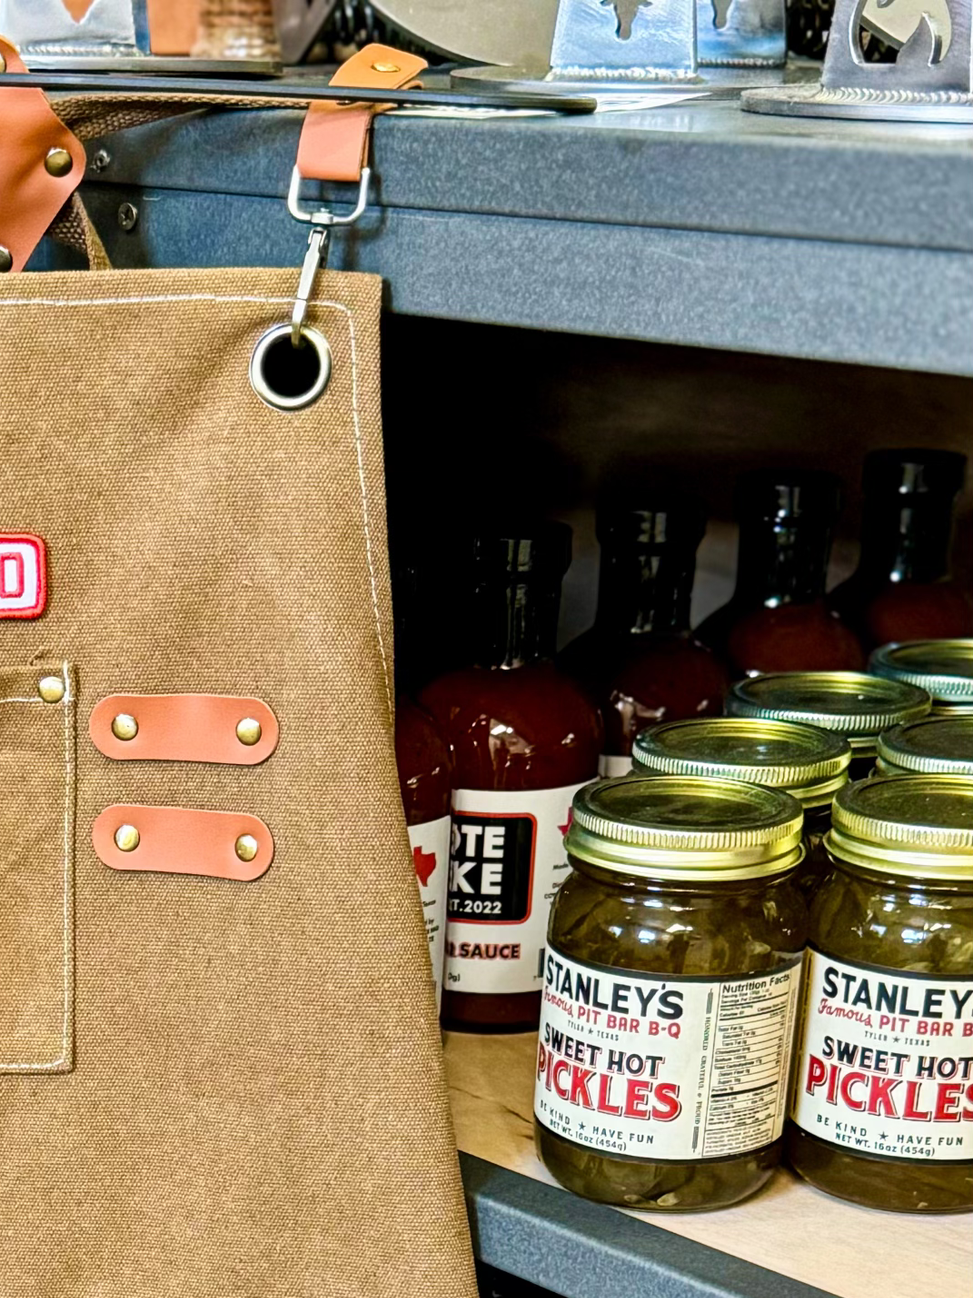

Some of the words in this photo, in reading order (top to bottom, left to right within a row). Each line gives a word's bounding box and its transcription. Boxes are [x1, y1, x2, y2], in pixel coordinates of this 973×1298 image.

[460, 942, 521, 960] SAUCE
[546, 954, 684, 1021] STANLEY'S
[722, 977, 767, 994] Nutrition
[769, 973, 790, 987] Facts
[577, 1006, 602, 1026] PIT
[607, 1015, 640, 1034] BAR
[648, 1021, 681, 1040] B-Q
[818, 997, 873, 1029] Famous
[879, 1015, 910, 1033] PIT
[916, 1020, 954, 1037] BAR
[544, 1022, 602, 1066] SWEET
[607, 1050, 665, 1079] HOT
[596, 1029, 620, 1042] TEXAS
[864, 1030, 888, 1042] TYLER
[904, 1037, 931, 1047] TEXAS
[822, 1036, 910, 1077] SWEET
[916, 1055, 973, 1081] HOT
[537, 1040, 683, 1122] PICKLES
[549, 1106, 571, 1125] KIND
[592, 1126, 624, 1141] HAVE
[629, 1132, 654, 1145] FUN
[549, 1118, 560, 1131] NET
[575, 1131, 594, 1144] 16oz
[595, 1136, 627, 1152] (454g)
[816, 1114, 830, 1126] BE
[835, 1121, 867, 1137] KIND
[897, 1134, 932, 1146] HAVE
[938, 1136, 964, 1146] FUN
[835, 1132, 852, 1145] NET
[854, 1137, 871, 1149] WT.
[874, 1142, 897, 1153] 16oz
[900, 1145, 935, 1157] (454g)
